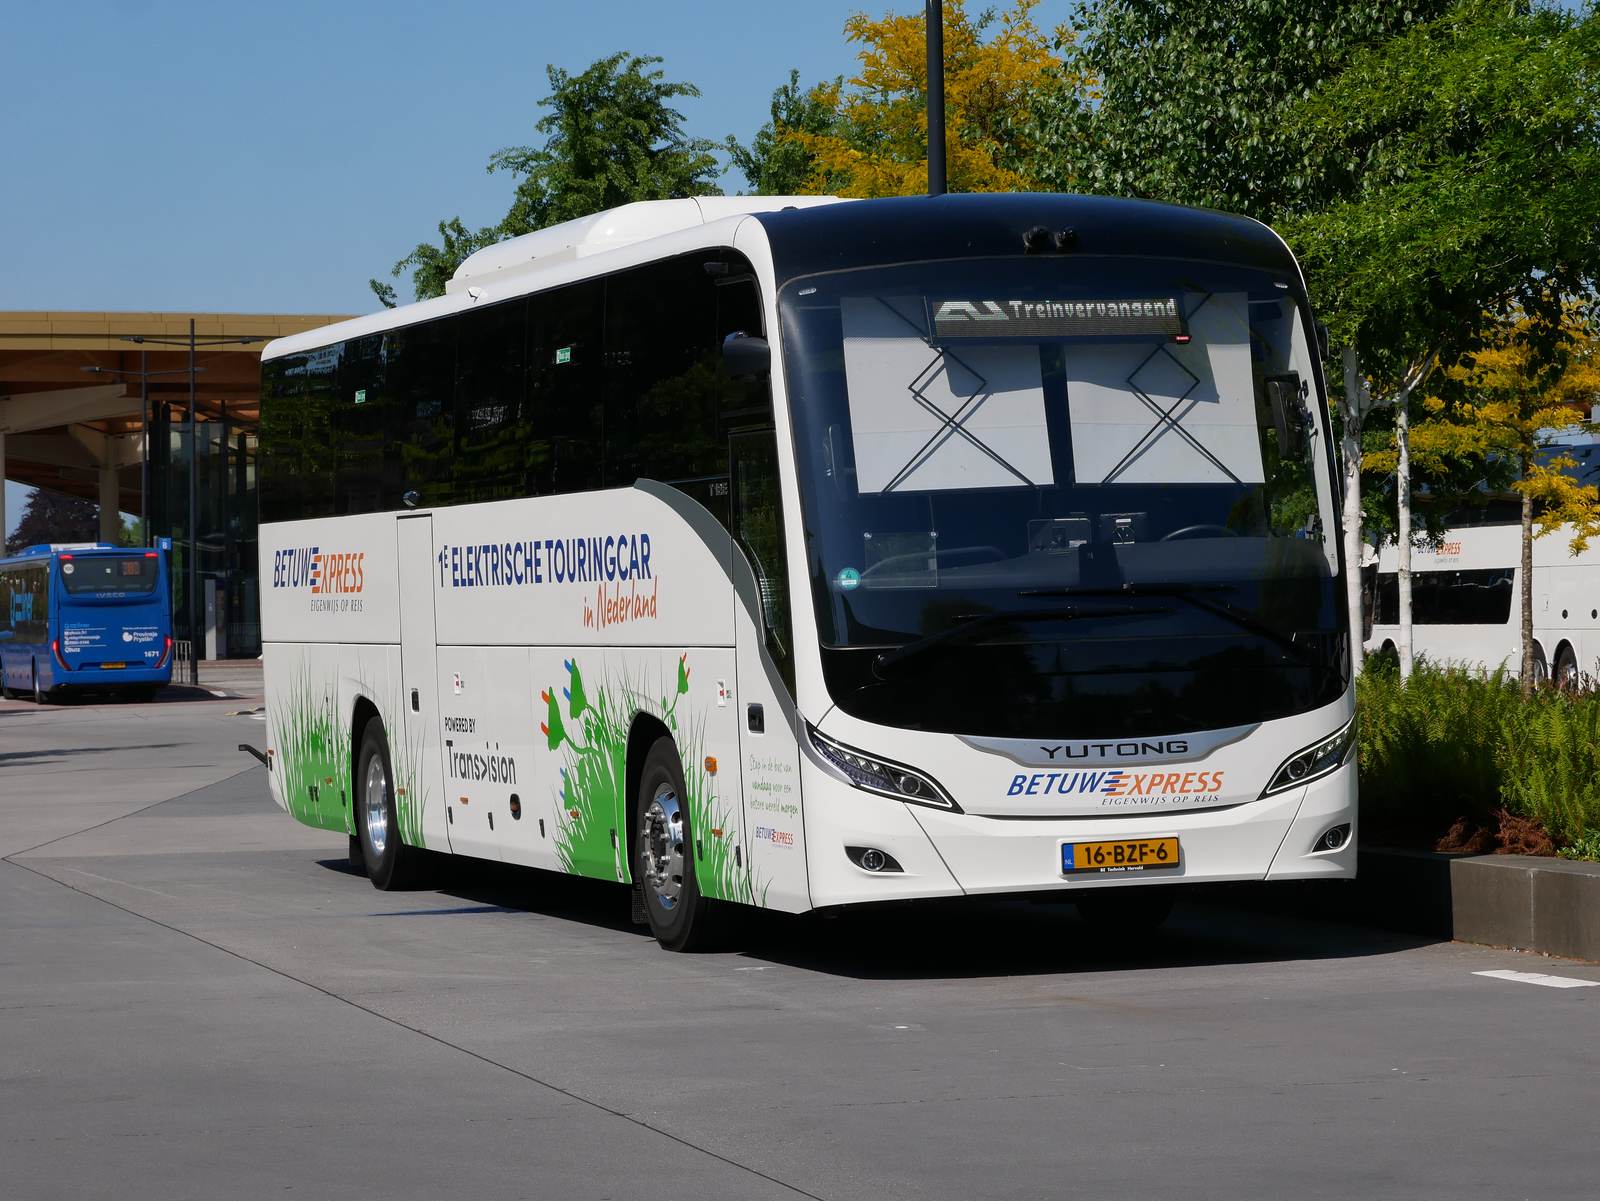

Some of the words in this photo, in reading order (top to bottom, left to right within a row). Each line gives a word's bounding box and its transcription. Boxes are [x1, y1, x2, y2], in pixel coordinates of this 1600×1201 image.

[451, 539, 543, 588] ELEKTRISCHE
[545, 533, 652, 584] TOURINGCAR
[310, 599, 339, 614] EIGENWIJS
[340, 599, 349, 612] OP
[351, 599, 363, 612] REIS
[583, 596, 594, 629] in
[597, 574, 658, 632] Nederland
[445, 717, 468, 733] POWERED
[469, 718, 476, 734] BY
[1040, 740, 1189, 760] YUTONG
[1101, 797, 1168, 806] EIGENWIJS
[1172, 796, 1189, 804] OP
[1194, 794, 1220, 803] REIS
[1084, 842, 1169, 865] 16-BZF-6
